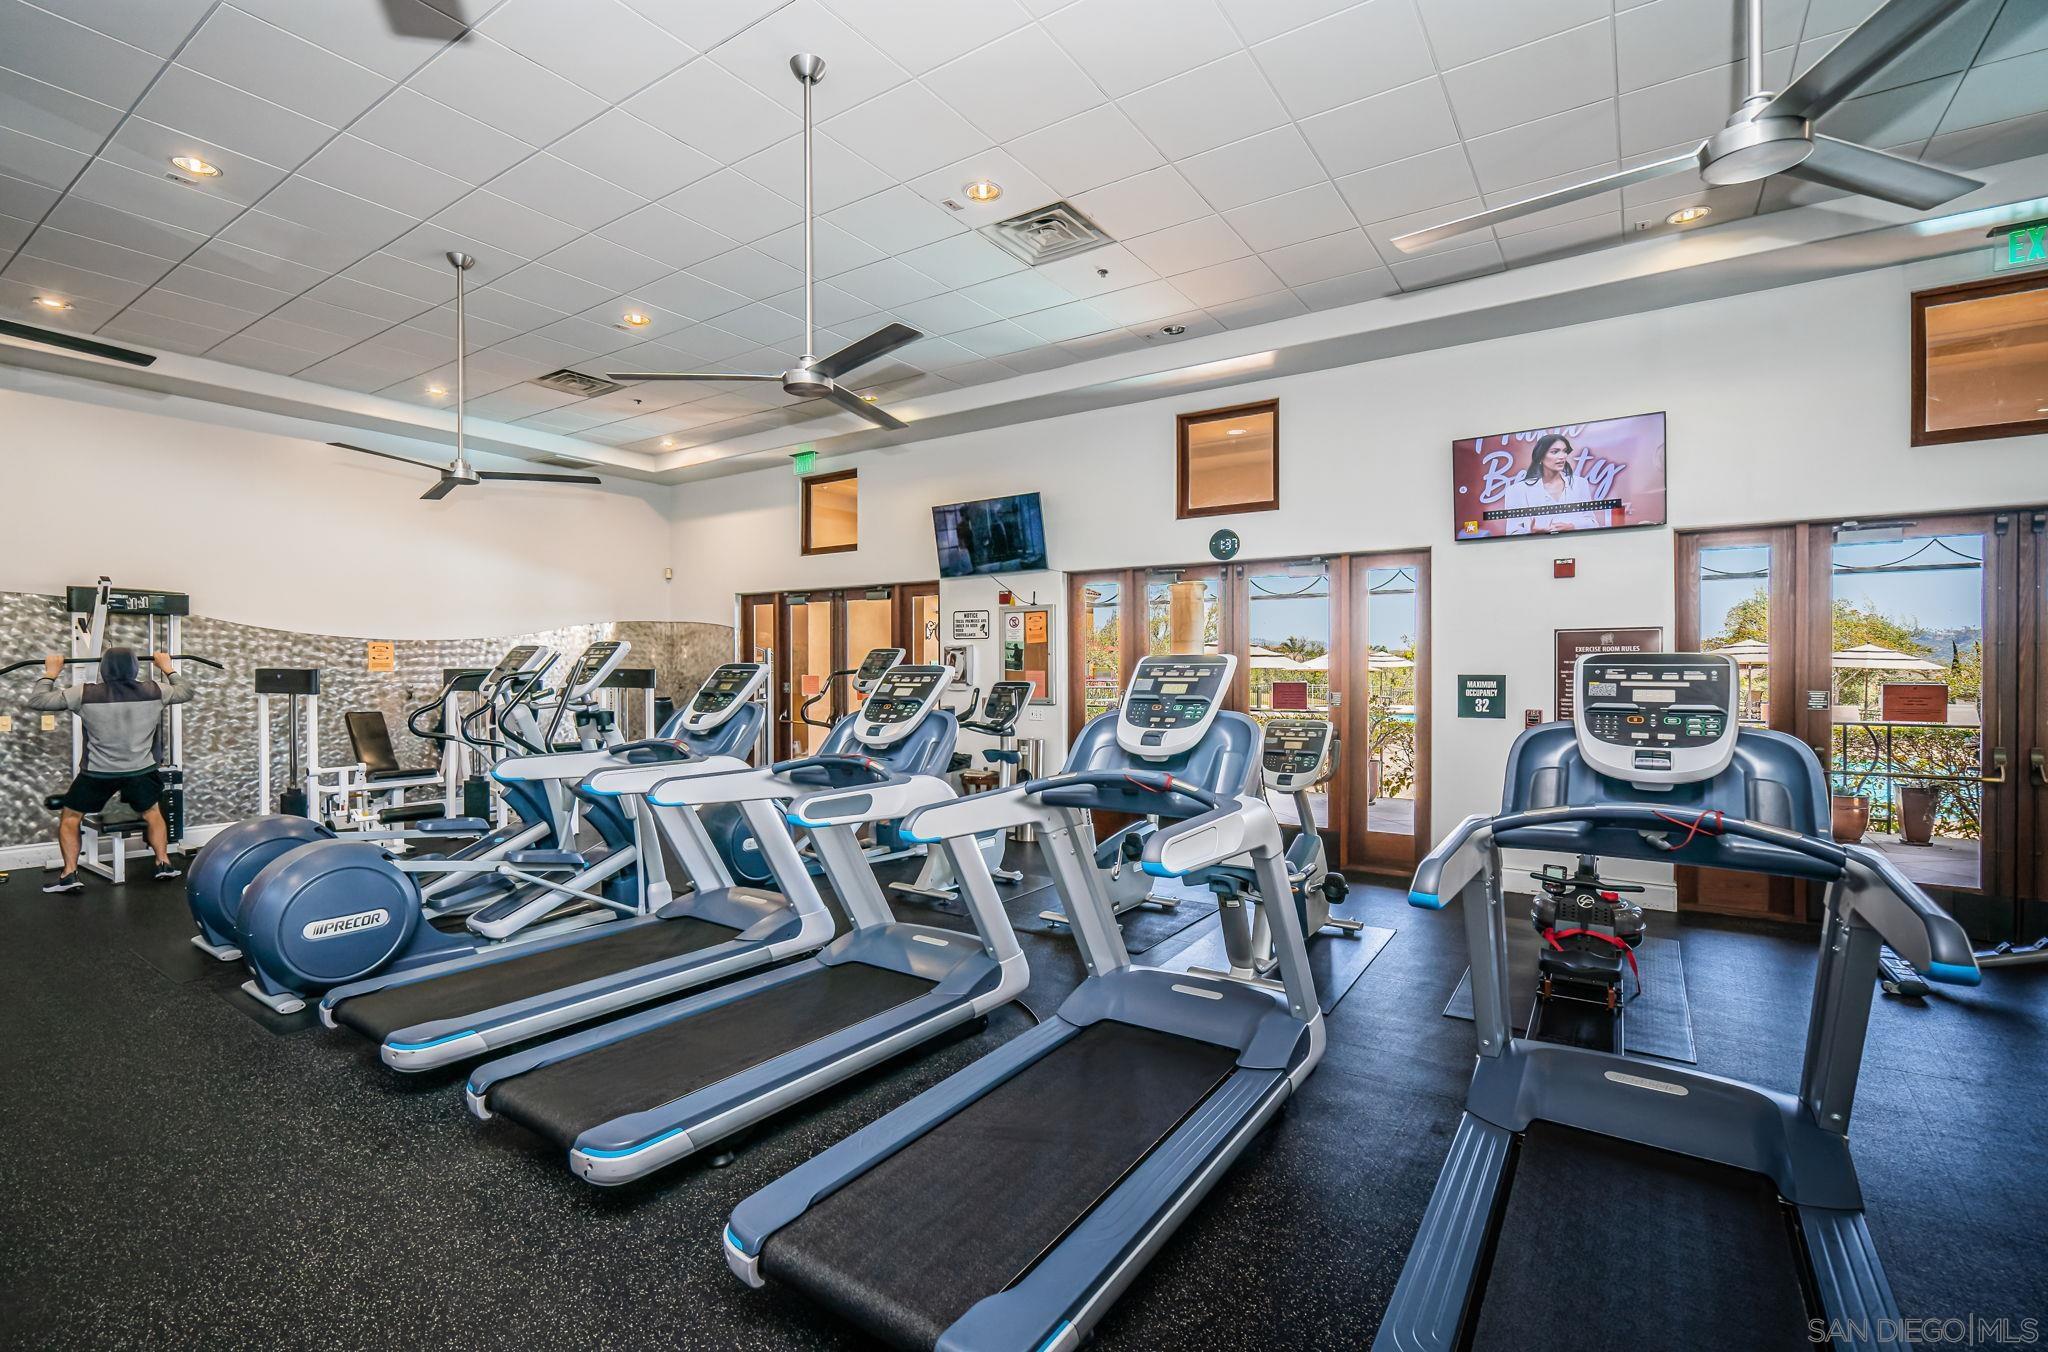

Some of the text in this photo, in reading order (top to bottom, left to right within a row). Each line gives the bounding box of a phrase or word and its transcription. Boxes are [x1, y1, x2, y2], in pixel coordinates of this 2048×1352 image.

[1480, 448, 1626, 504] Bety
[1466, 680, 1497, 688] MAXIMUM
[1465, 688, 1498, 696] OCCUPANCY
[1475, 698, 1489, 712] 32
[322, 912, 381, 934] PRECOR
